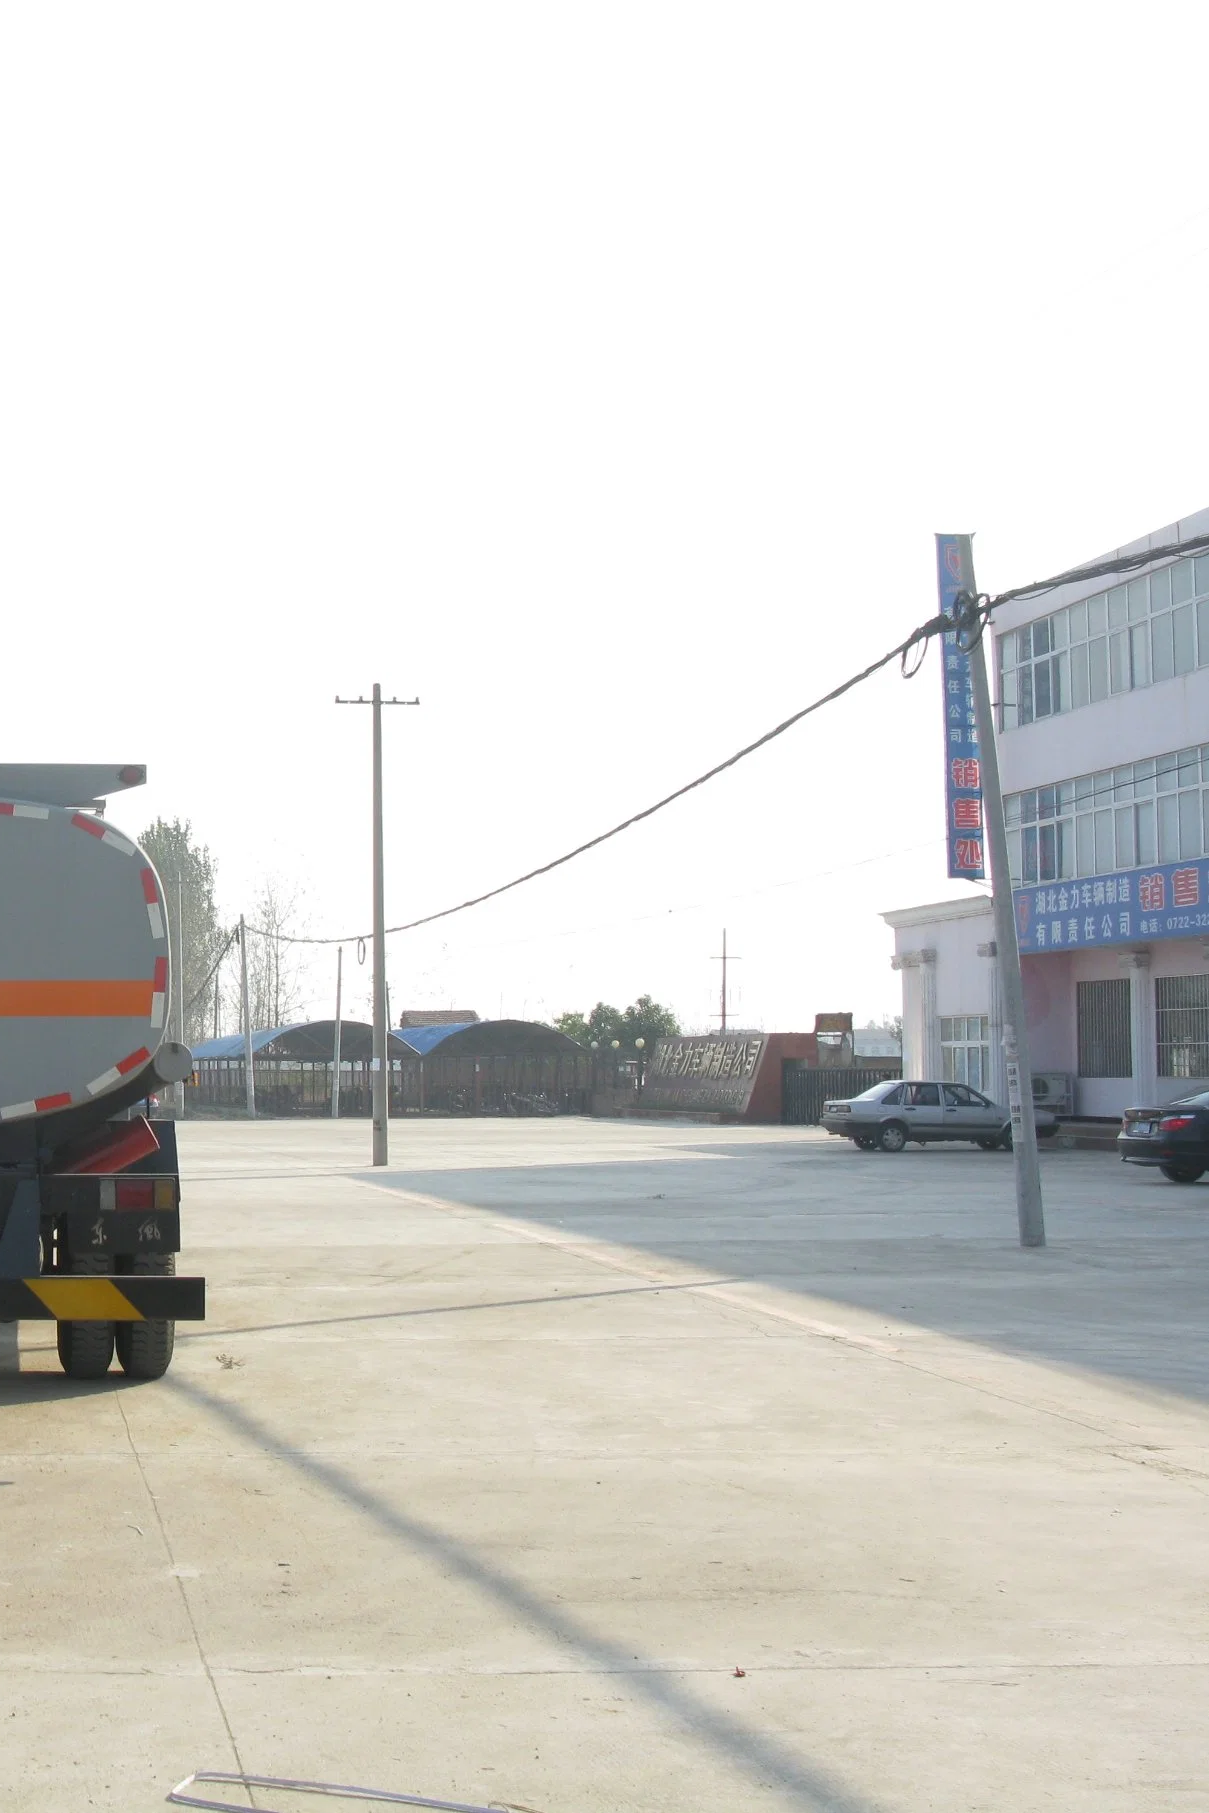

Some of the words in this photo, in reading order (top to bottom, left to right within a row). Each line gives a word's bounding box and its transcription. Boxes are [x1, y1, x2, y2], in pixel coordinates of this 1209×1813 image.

[951, 757, 983, 870] 销售处
[1035, 877, 1131, 914] 湖北金力车辆制造
[1138, 867, 1209, 913] 销售
[1035, 911, 1131, 946] 有限责任公司
